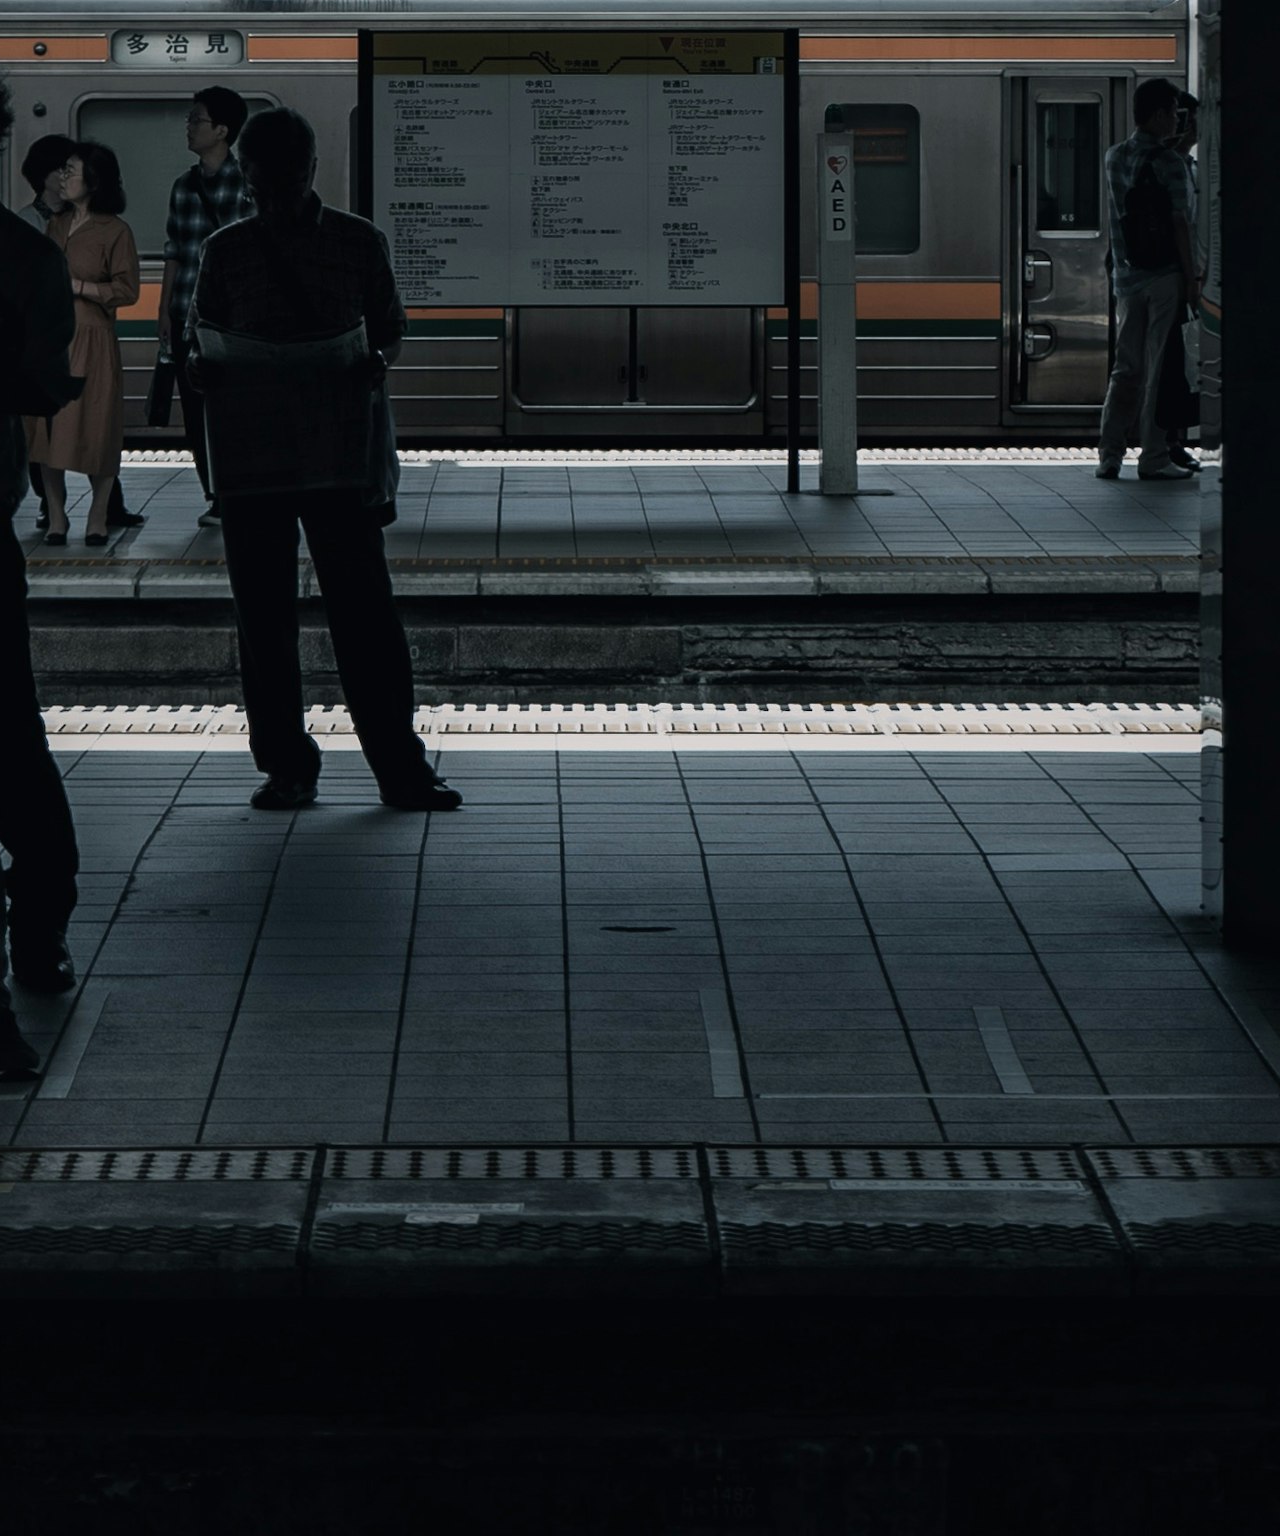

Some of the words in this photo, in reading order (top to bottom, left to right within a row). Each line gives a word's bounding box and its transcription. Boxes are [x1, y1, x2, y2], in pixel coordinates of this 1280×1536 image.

[126, 33, 229, 55] 多治見
[525, 80, 552, 88] 中央口
[831, 179, 846, 231] AED
[662, 222, 698, 231] 中央北口
